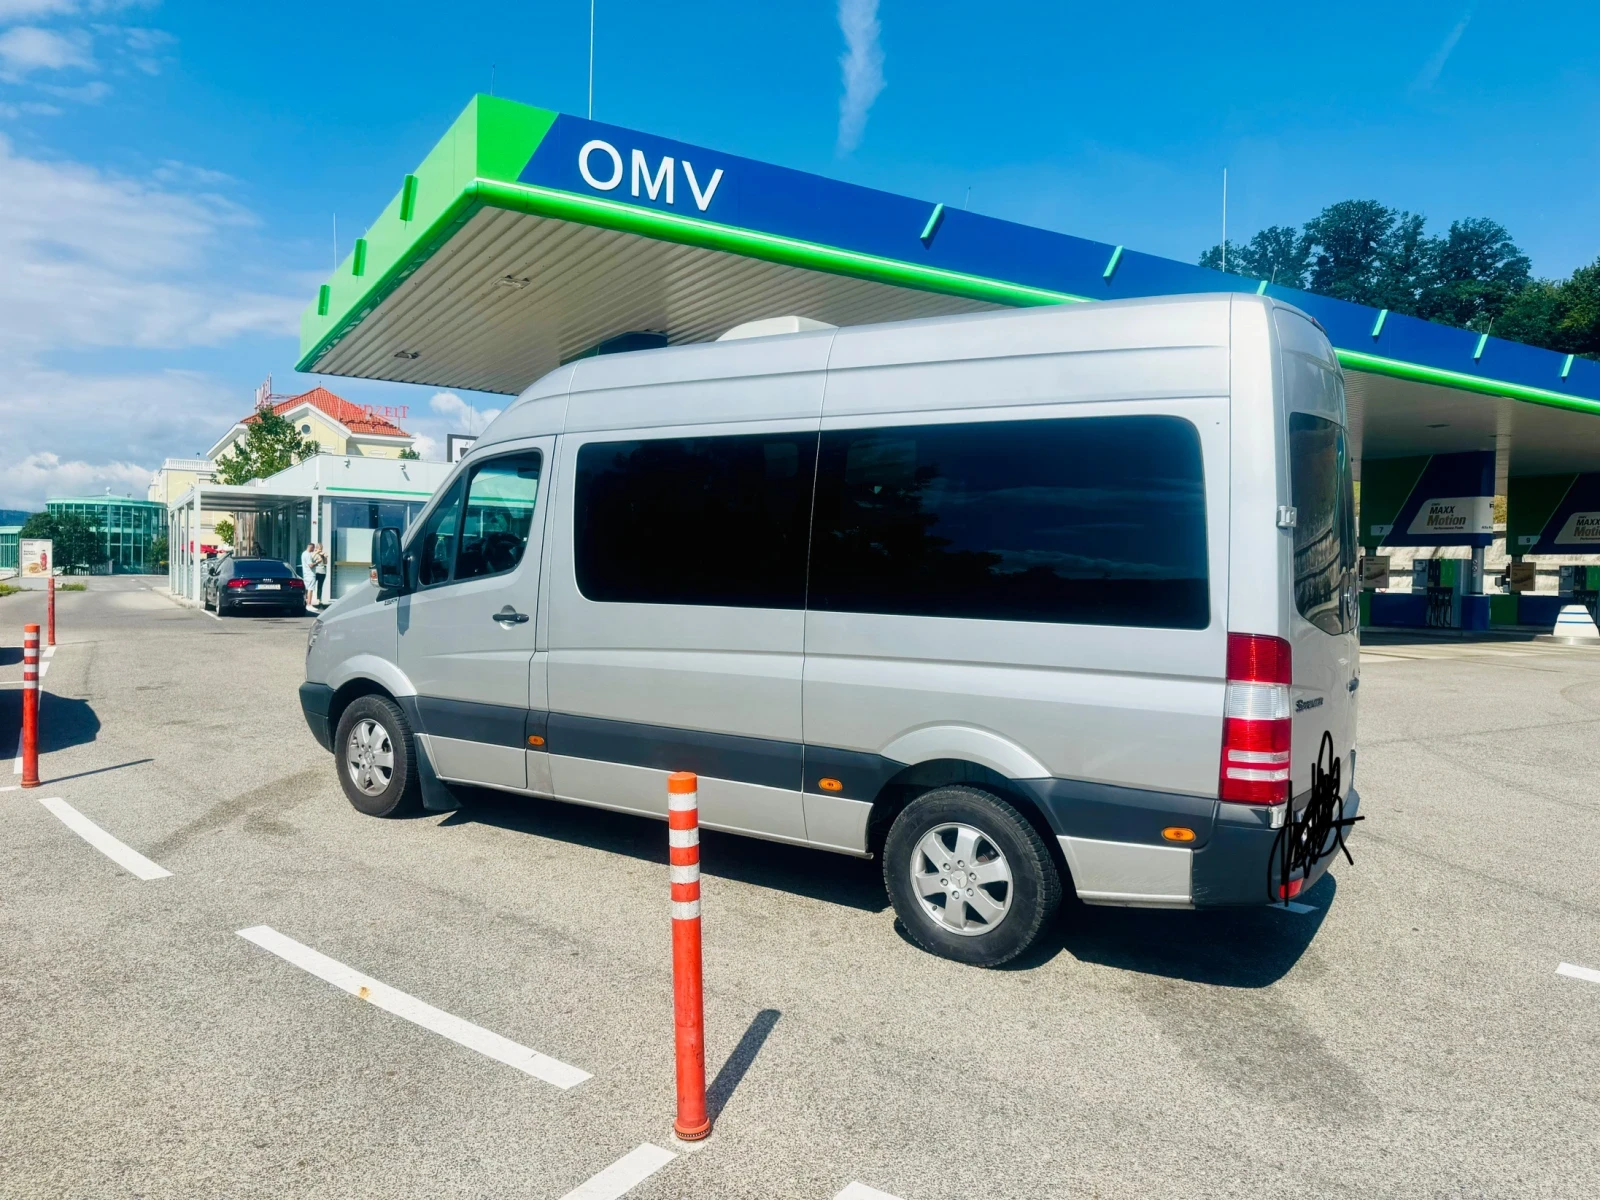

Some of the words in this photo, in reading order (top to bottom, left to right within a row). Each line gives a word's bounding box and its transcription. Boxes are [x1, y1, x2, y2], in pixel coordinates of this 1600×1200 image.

[578, 140, 725, 212] OMV
[1430, 505, 1456, 515] MAXX
[1426, 514, 1467, 527] Motion
[1379, 526, 1384, 534] 7
[1573, 525, 1600, 537] Moti
